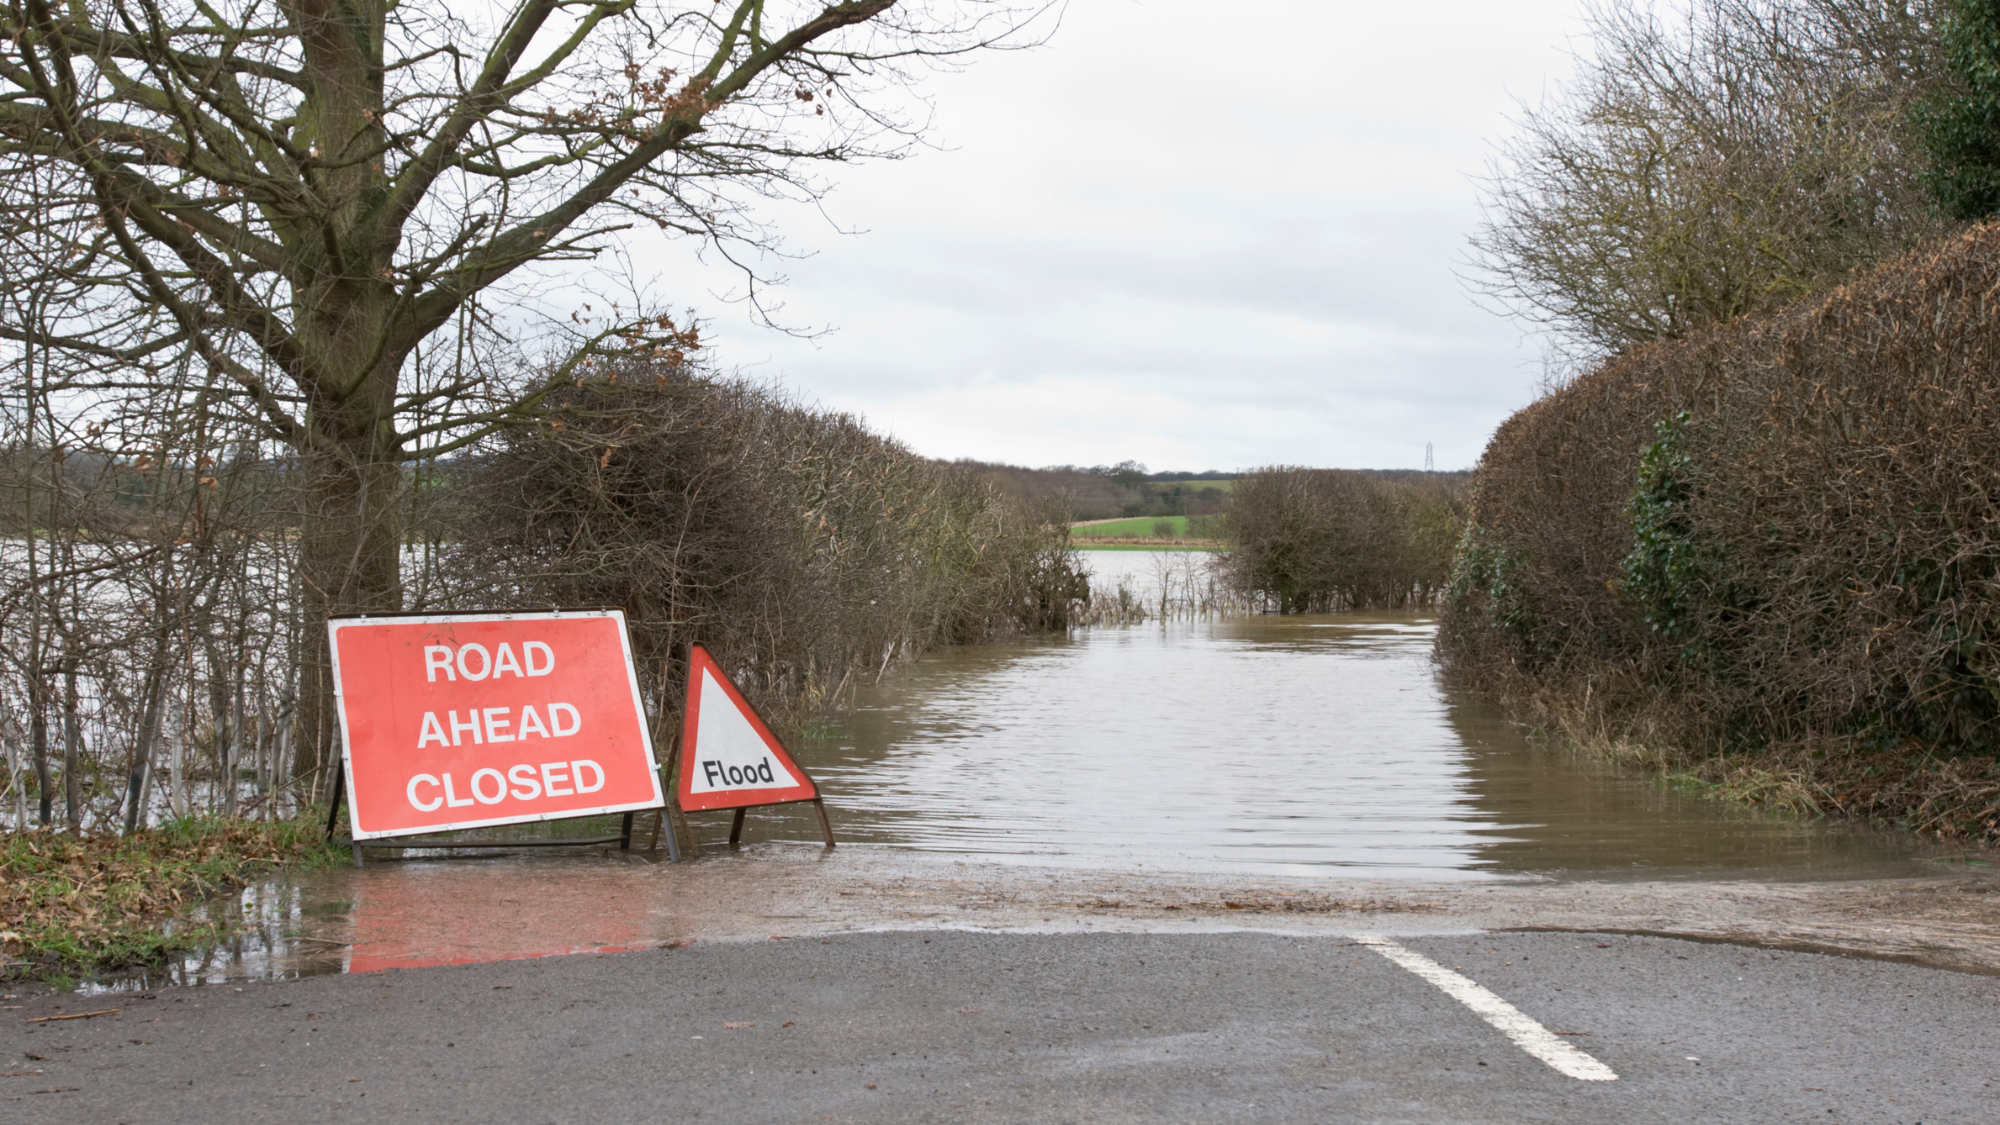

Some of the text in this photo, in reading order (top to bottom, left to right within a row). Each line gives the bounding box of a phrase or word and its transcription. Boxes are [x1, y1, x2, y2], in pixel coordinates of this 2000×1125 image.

[424, 641, 556, 683] ROAD
[417, 702, 582, 749] AHEAD
[406, 759, 606, 812] CLOSED
[702, 756, 775, 788] Flood
